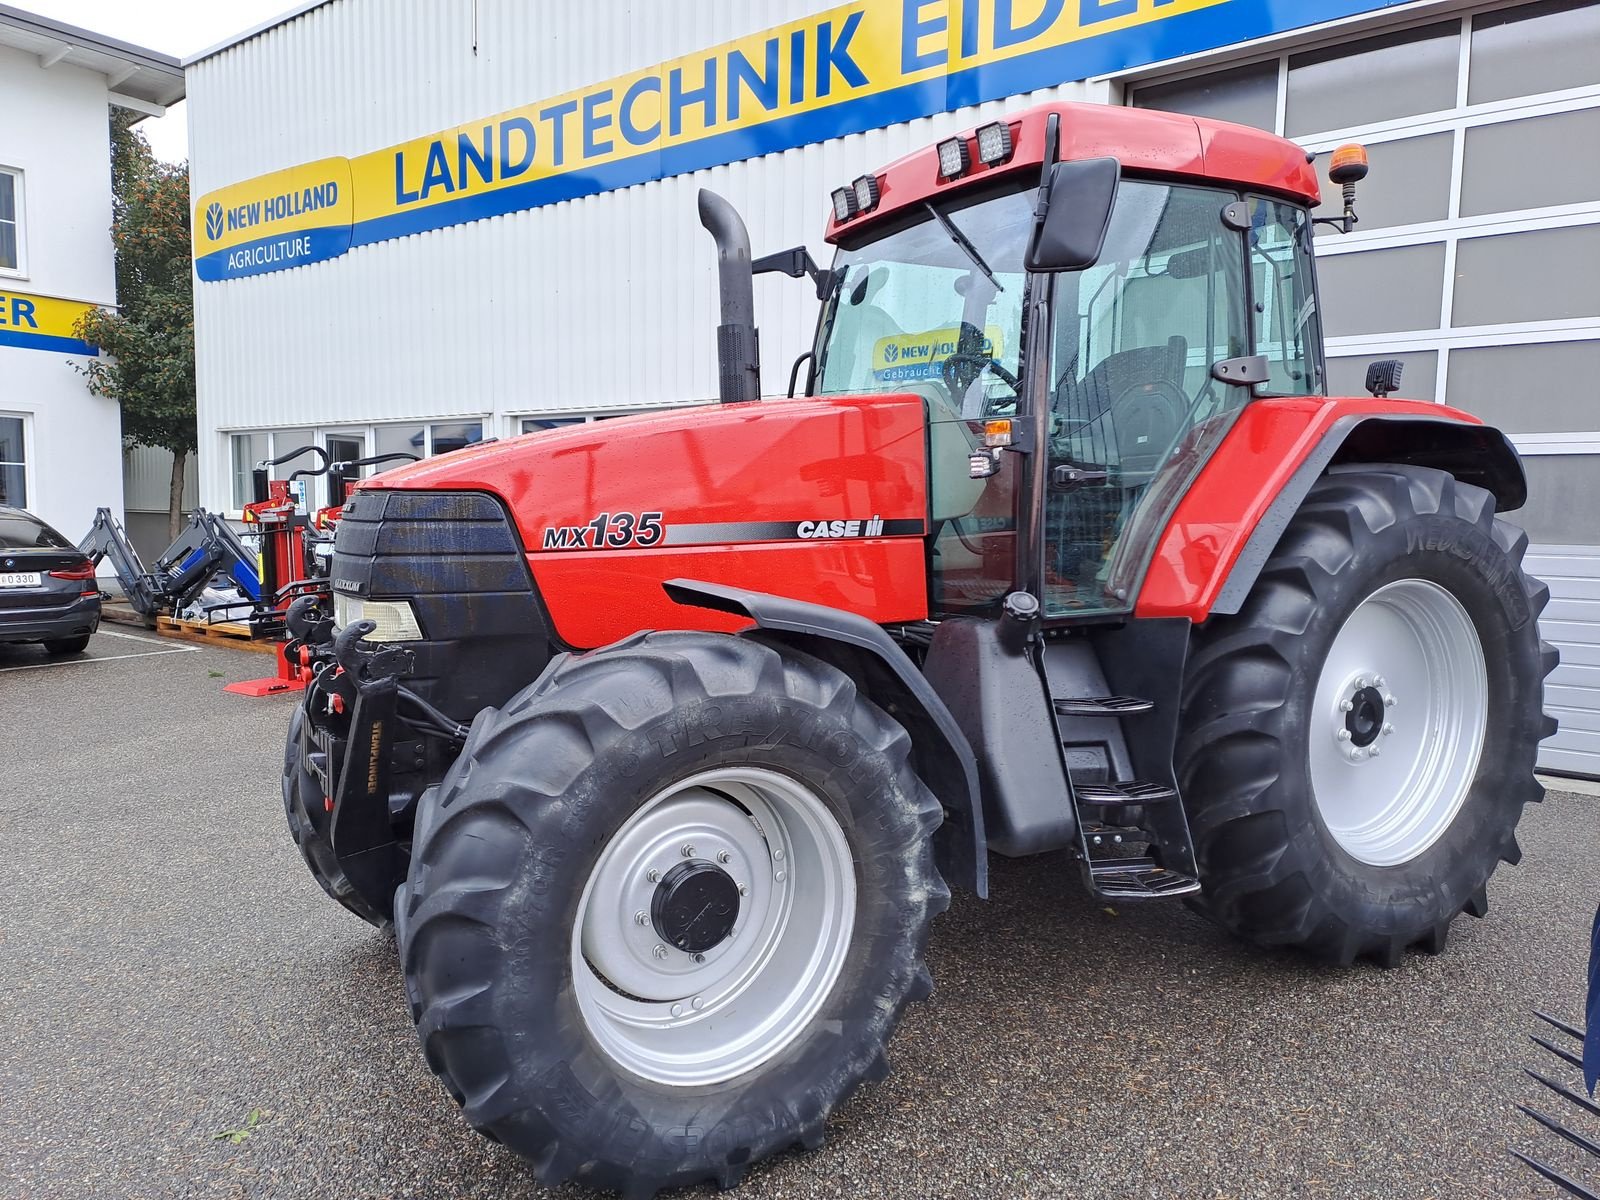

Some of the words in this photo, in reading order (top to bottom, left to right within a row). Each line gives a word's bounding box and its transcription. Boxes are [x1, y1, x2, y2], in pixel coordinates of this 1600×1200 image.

[395, 10, 871, 206] LANDTECHNIK
[227, 201, 260, 232] NEW
[264, 181, 338, 223] HOLLAND
[228, 236, 311, 271] AGRICULTURE
[901, 345, 930, 359] NEW
[797, 520, 861, 539] CASE
